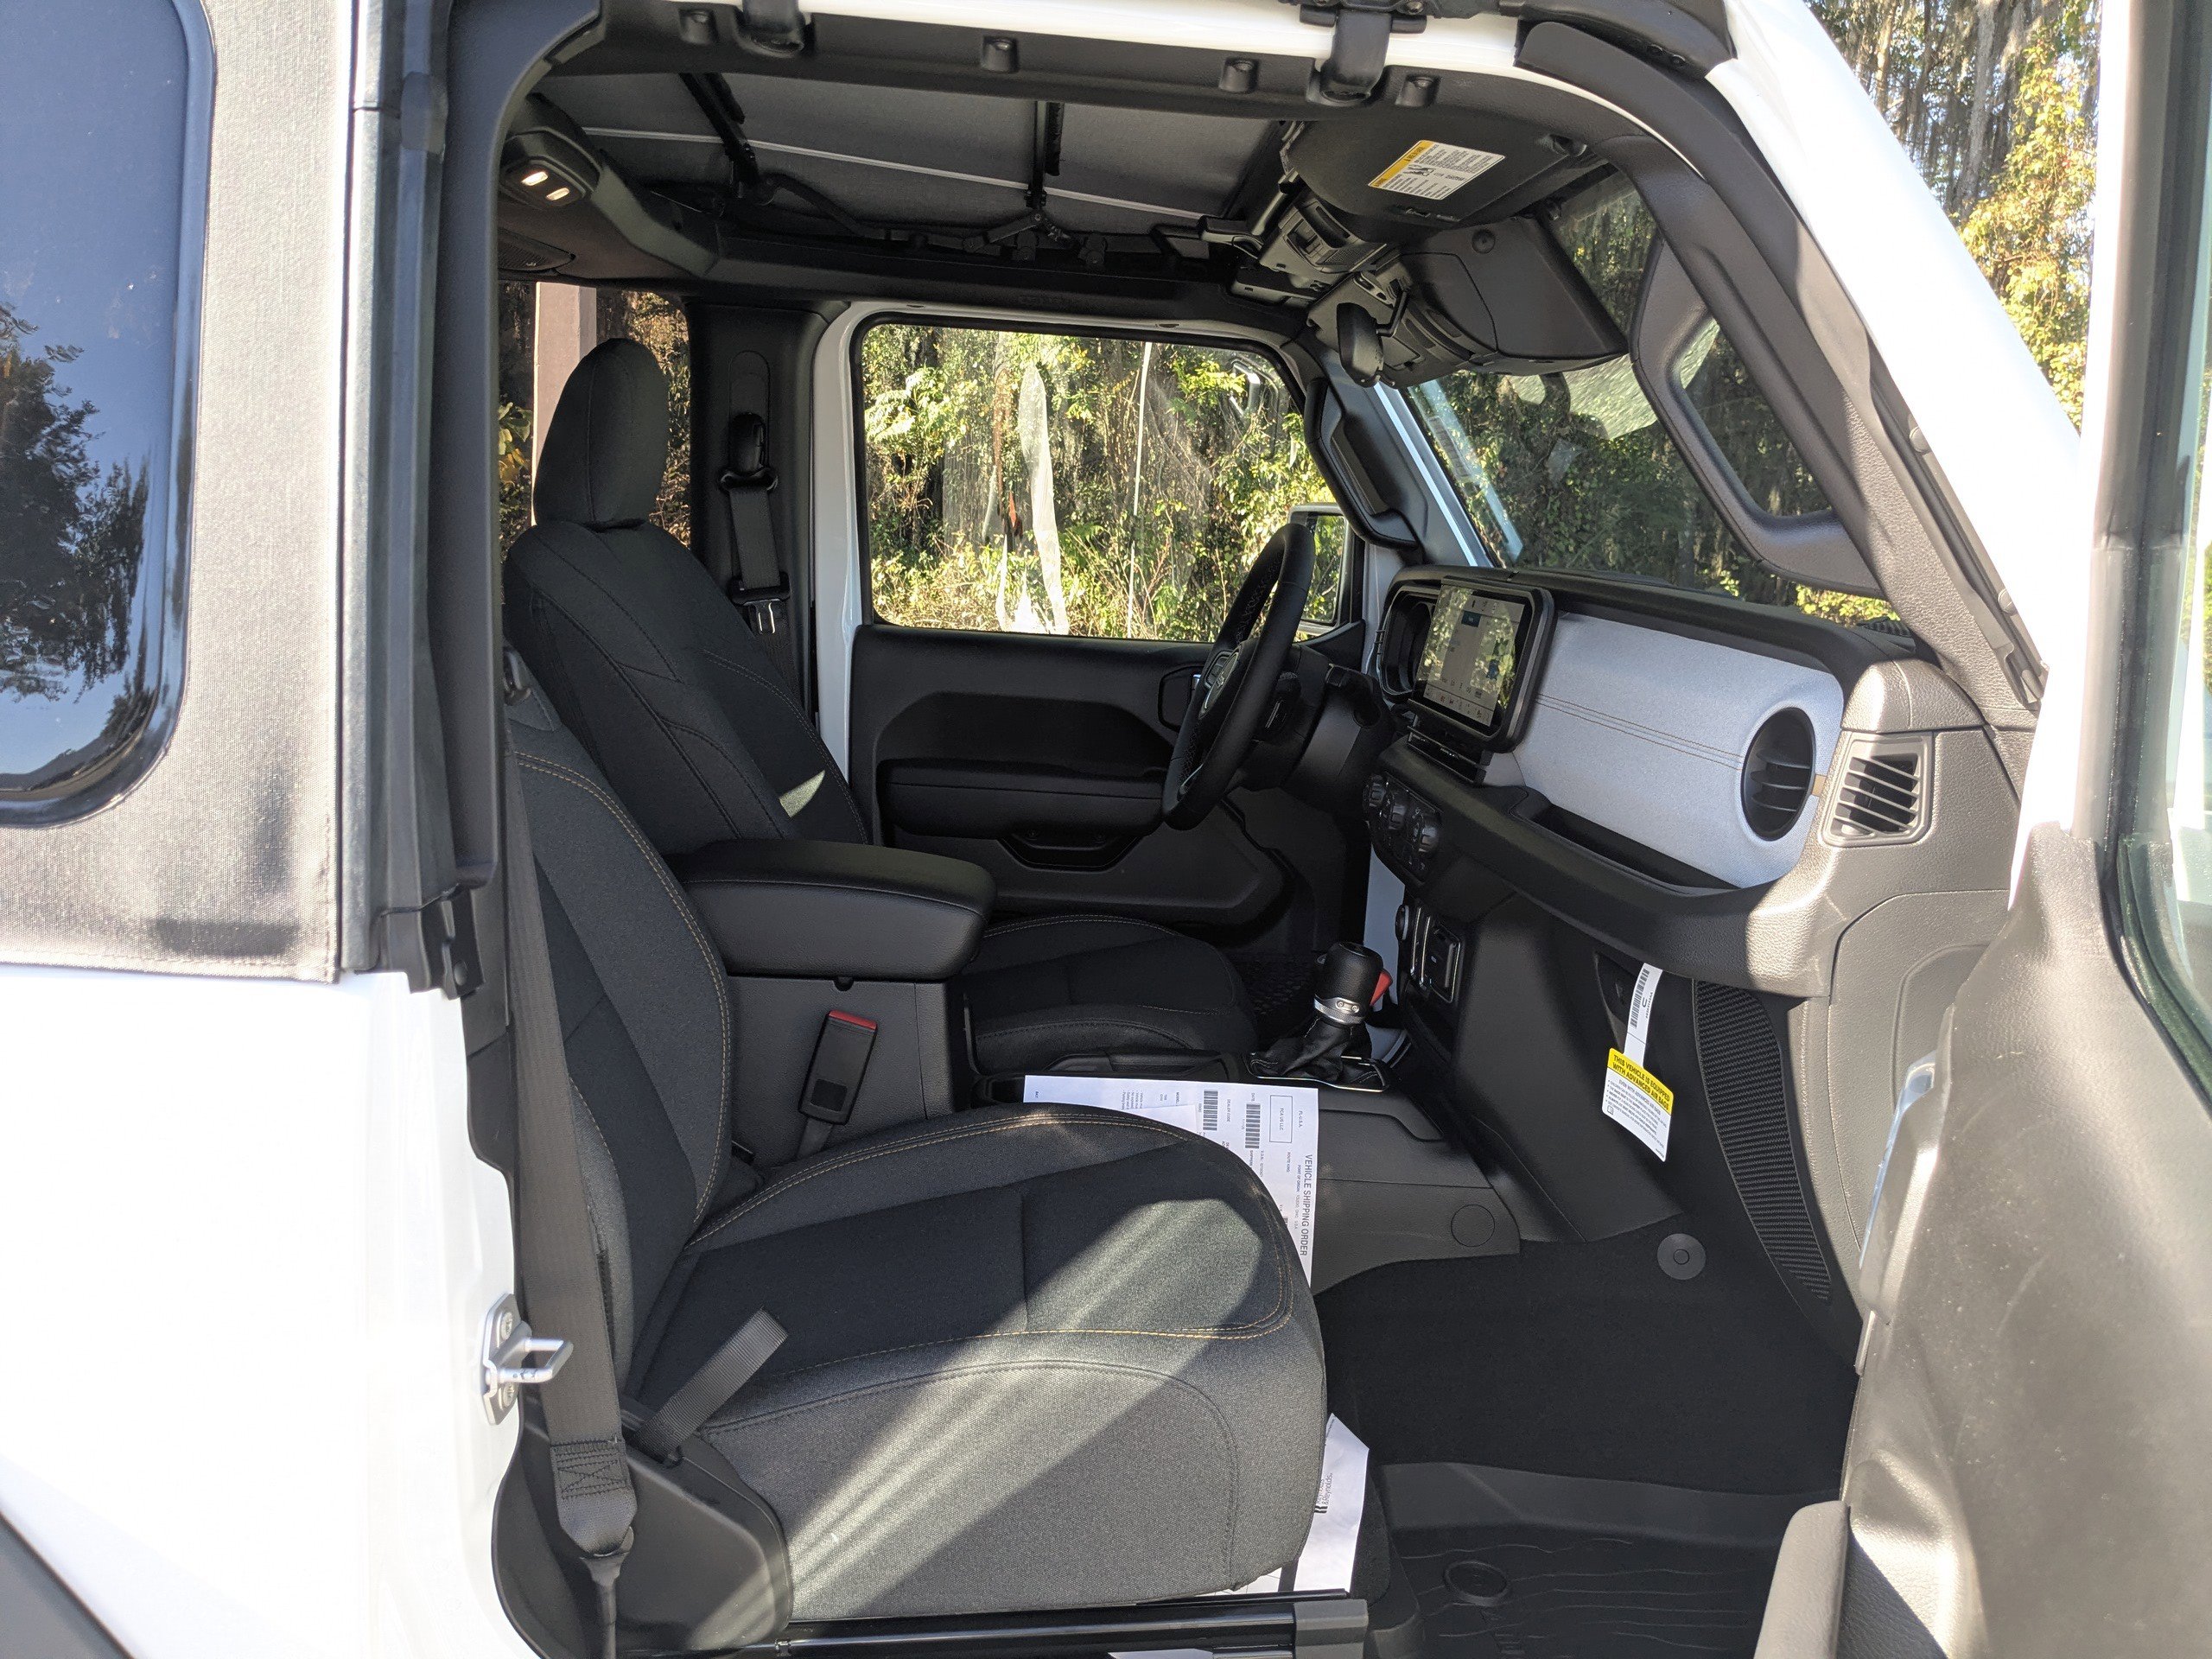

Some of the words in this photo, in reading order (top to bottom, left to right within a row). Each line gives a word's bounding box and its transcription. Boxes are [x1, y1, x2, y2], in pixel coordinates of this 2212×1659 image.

[1612, 1062, 1625, 1075] WITH
[1626, 1071, 1650, 1094] ADVANCED
[1658, 1096, 1669, 1110] BAGS
[1613, 1054, 1624, 1066] THIS
[1625, 1062, 1644, 1080] VEHICLE
[1645, 1076, 1649, 1084] IS
[1649, 1080, 1669, 1102] EQUIPPED
[1304, 1154, 1313, 1188] VEHICLE
[1301, 1191, 1311, 1226] SHIPPING
[1300, 1229, 1309, 1255] ORDER
